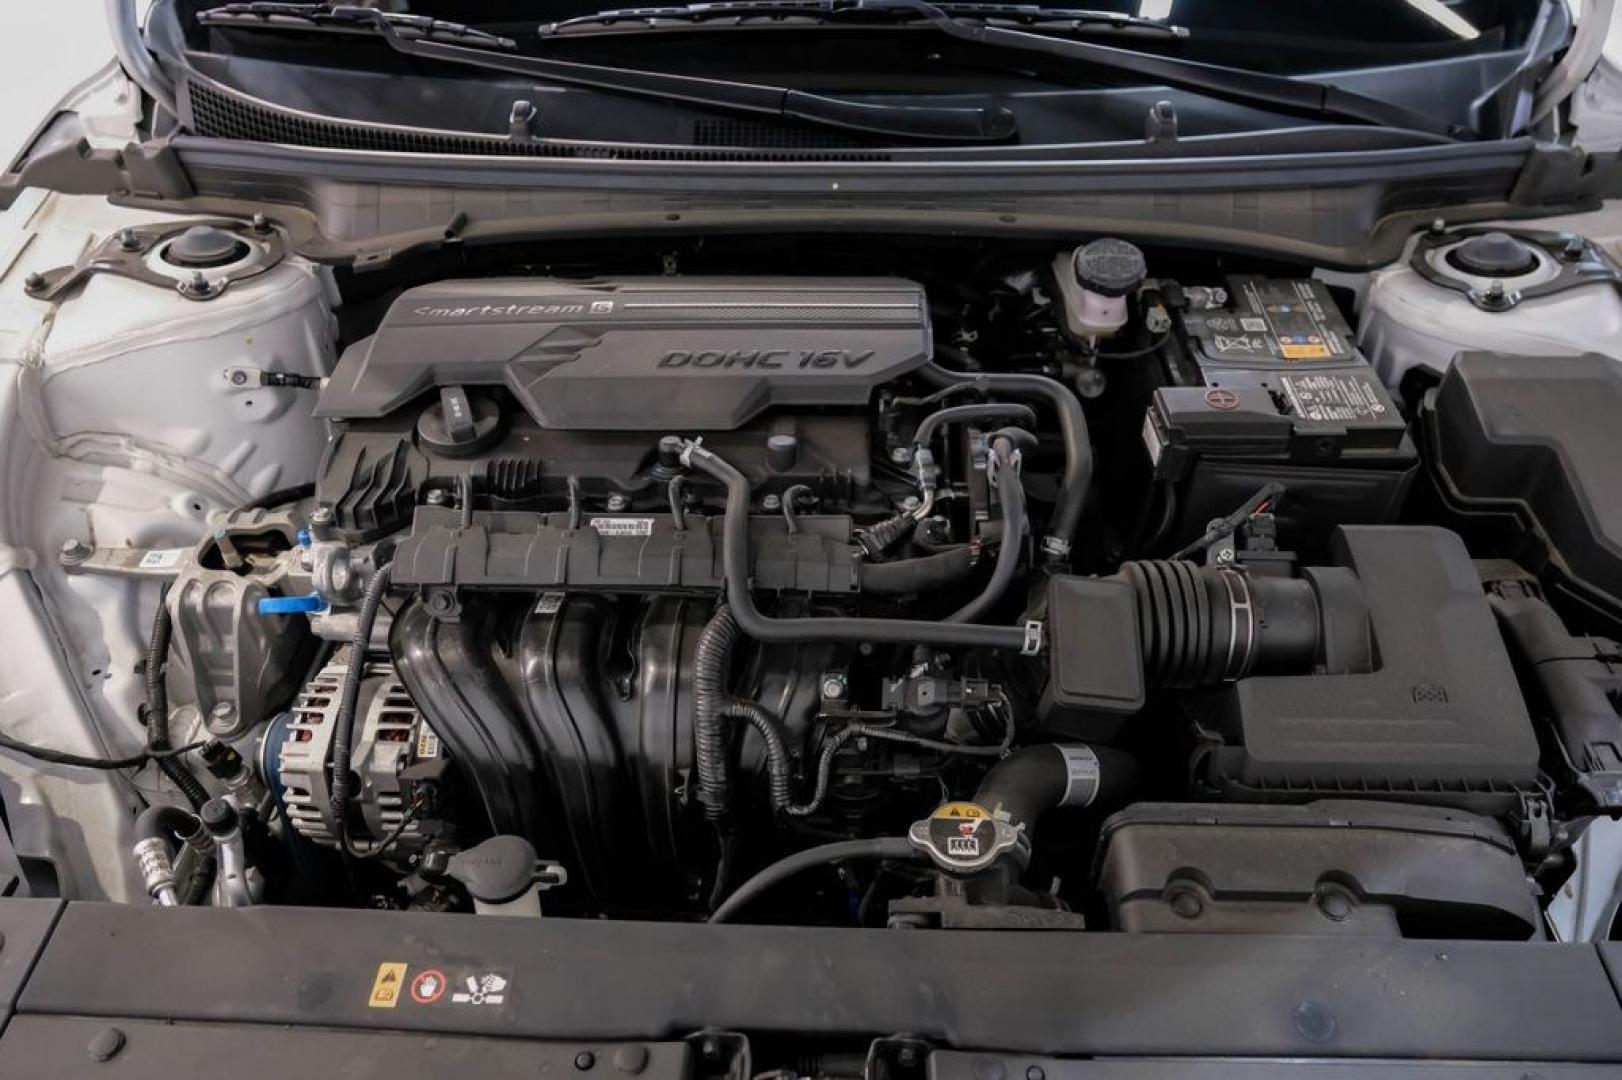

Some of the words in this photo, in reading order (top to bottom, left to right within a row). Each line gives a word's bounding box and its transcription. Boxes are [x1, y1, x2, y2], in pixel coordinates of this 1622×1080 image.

[413, 303, 585, 317] Smartstream
[657, 351, 790, 369] DOHC
[798, 351, 876, 369] 16V
